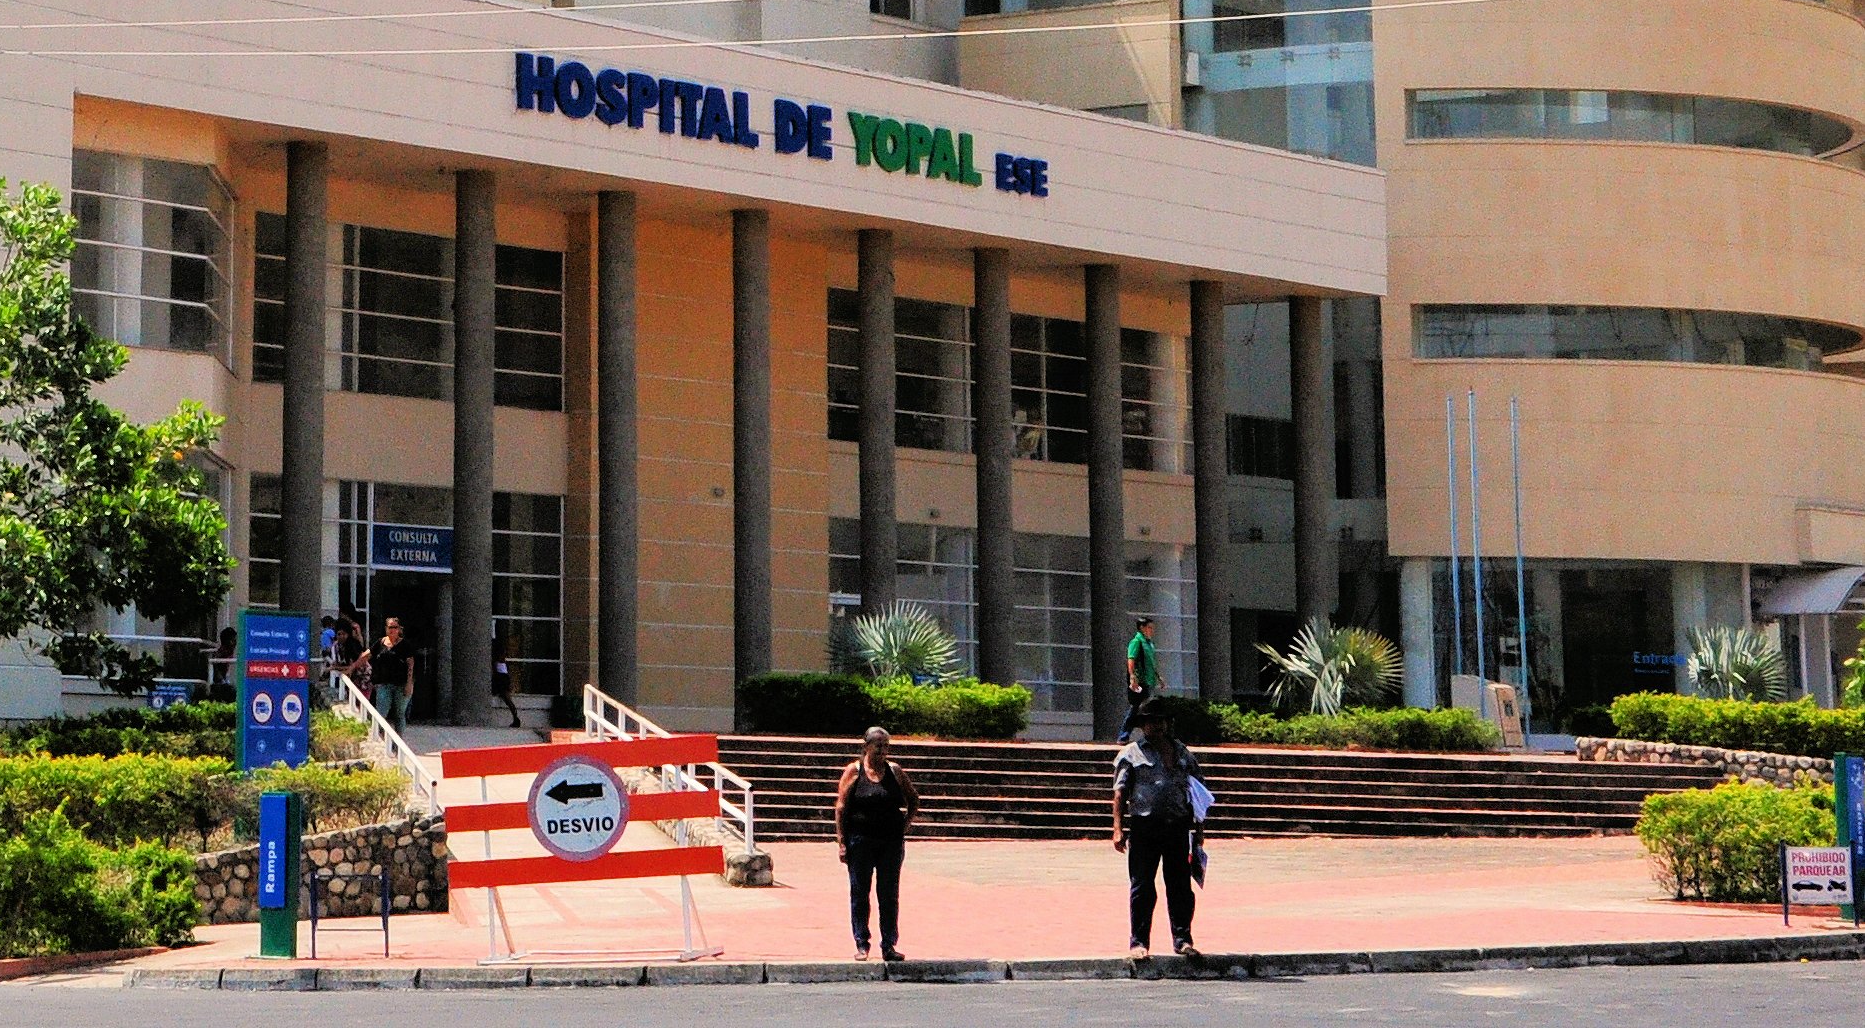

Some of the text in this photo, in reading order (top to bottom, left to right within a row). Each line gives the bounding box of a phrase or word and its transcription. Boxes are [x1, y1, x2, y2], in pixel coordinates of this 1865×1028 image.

[514, 51, 1049, 198] HOSPITAL DE YOPAL ESE
[388, 530, 439, 545] CONSULTA
[390, 548, 438, 563] EXTERNA
[546, 816, 614, 835] DESVIO
[1791, 851, 1846, 864] PROHIBIDO
[265, 841, 277, 894] Rampa
[1792, 865, 1847, 877] PARQUEAR
